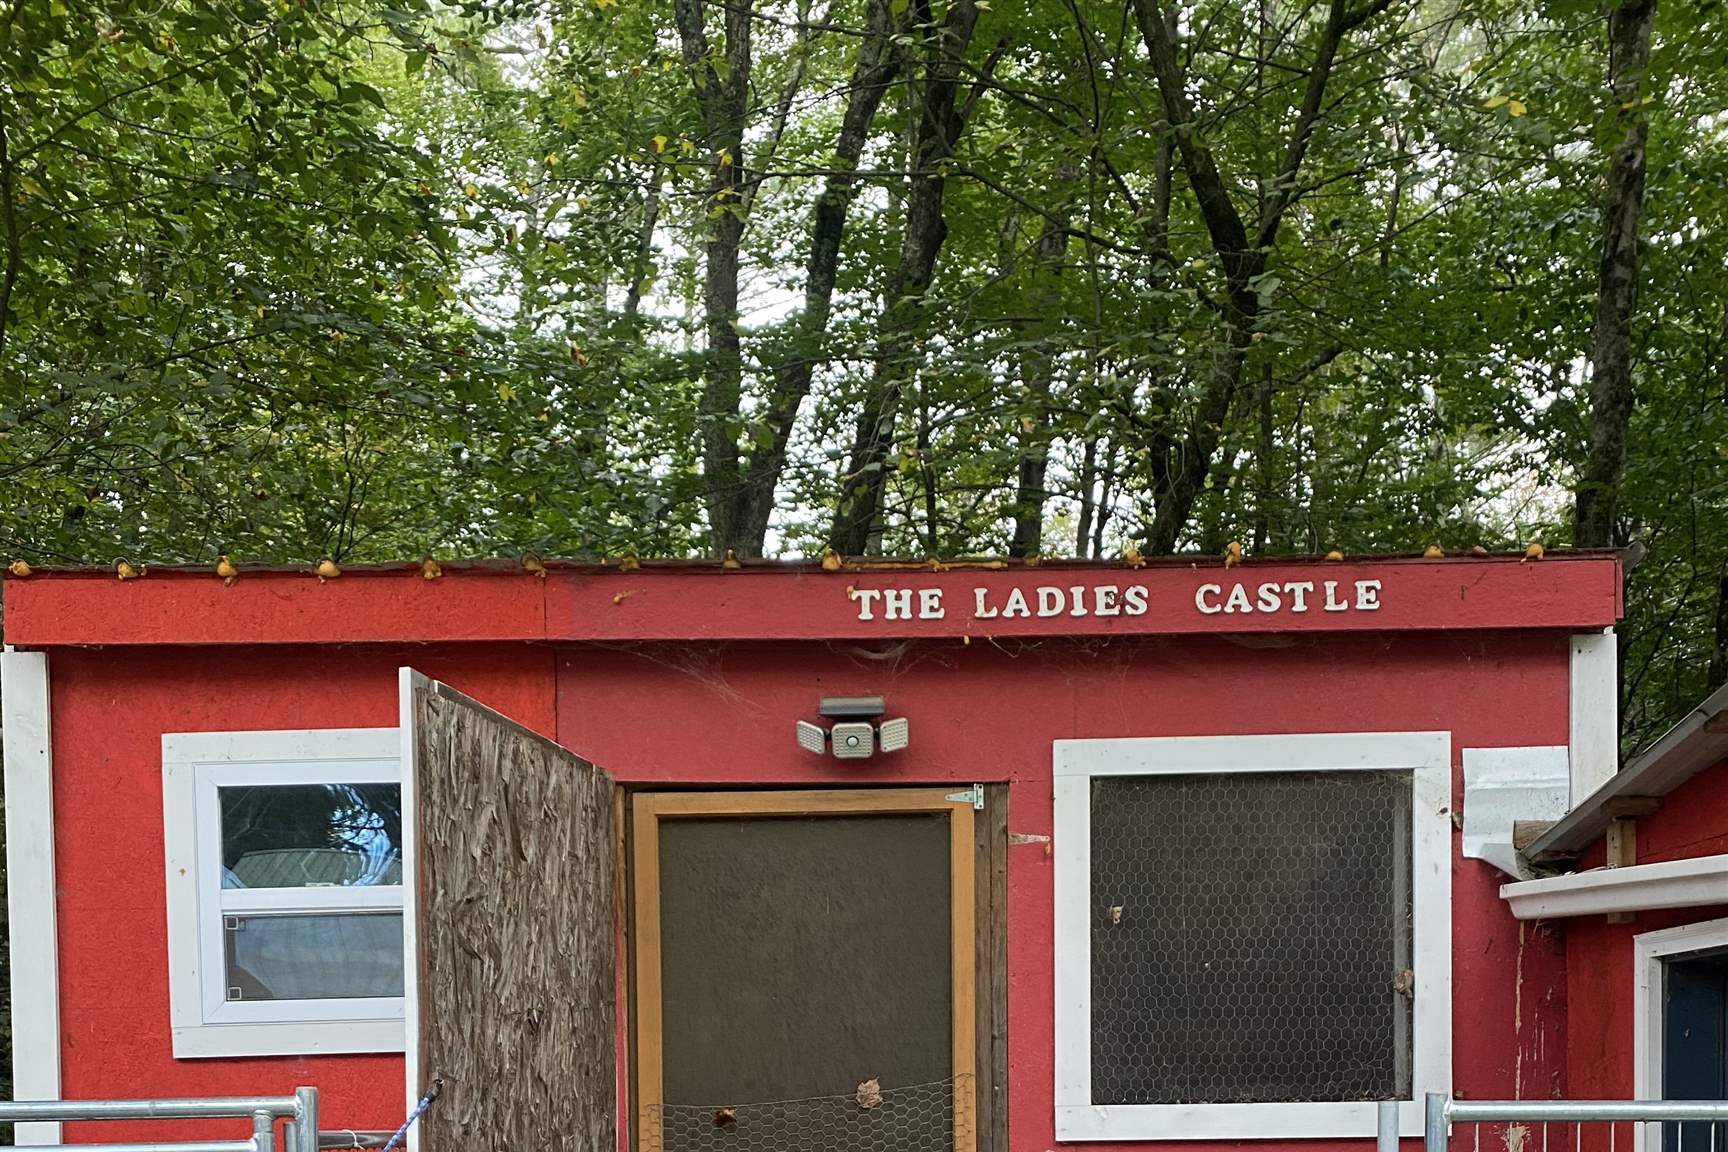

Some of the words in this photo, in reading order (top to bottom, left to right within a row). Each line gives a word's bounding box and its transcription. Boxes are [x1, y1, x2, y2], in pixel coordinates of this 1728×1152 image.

[851, 587, 946, 622] THE
[973, 584, 1150, 620] LADIES
[1194, 579, 1383, 616] CASTLE
